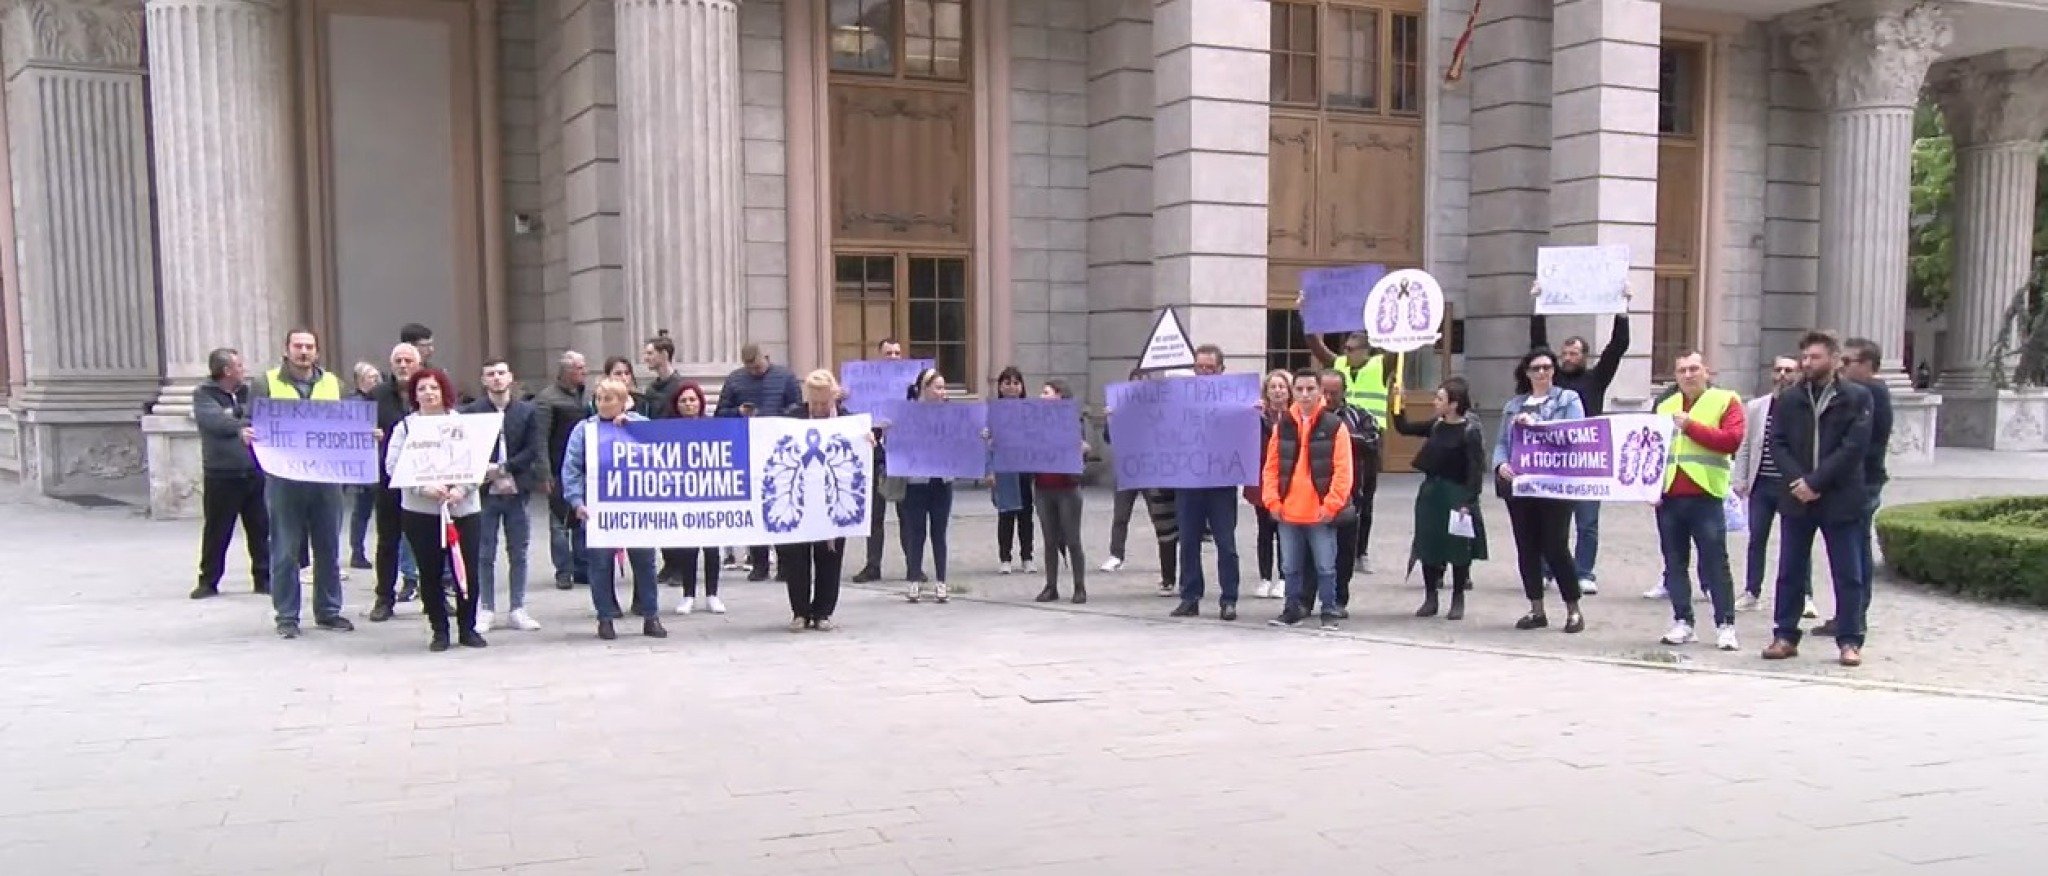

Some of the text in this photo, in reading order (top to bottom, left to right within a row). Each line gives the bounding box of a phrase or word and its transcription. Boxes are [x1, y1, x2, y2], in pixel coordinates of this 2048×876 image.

[1568, 425, 1600, 445] СМЕ
[613, 441, 733, 469] РЕТКИ СМЕ
[1520, 451, 1609, 469] И ПОСТОИМЕ
[607, 469, 745, 497] И ПОСТОИМЕ
[598, 509, 754, 531] ЦИСТИЧНА ФИБРОЗА
